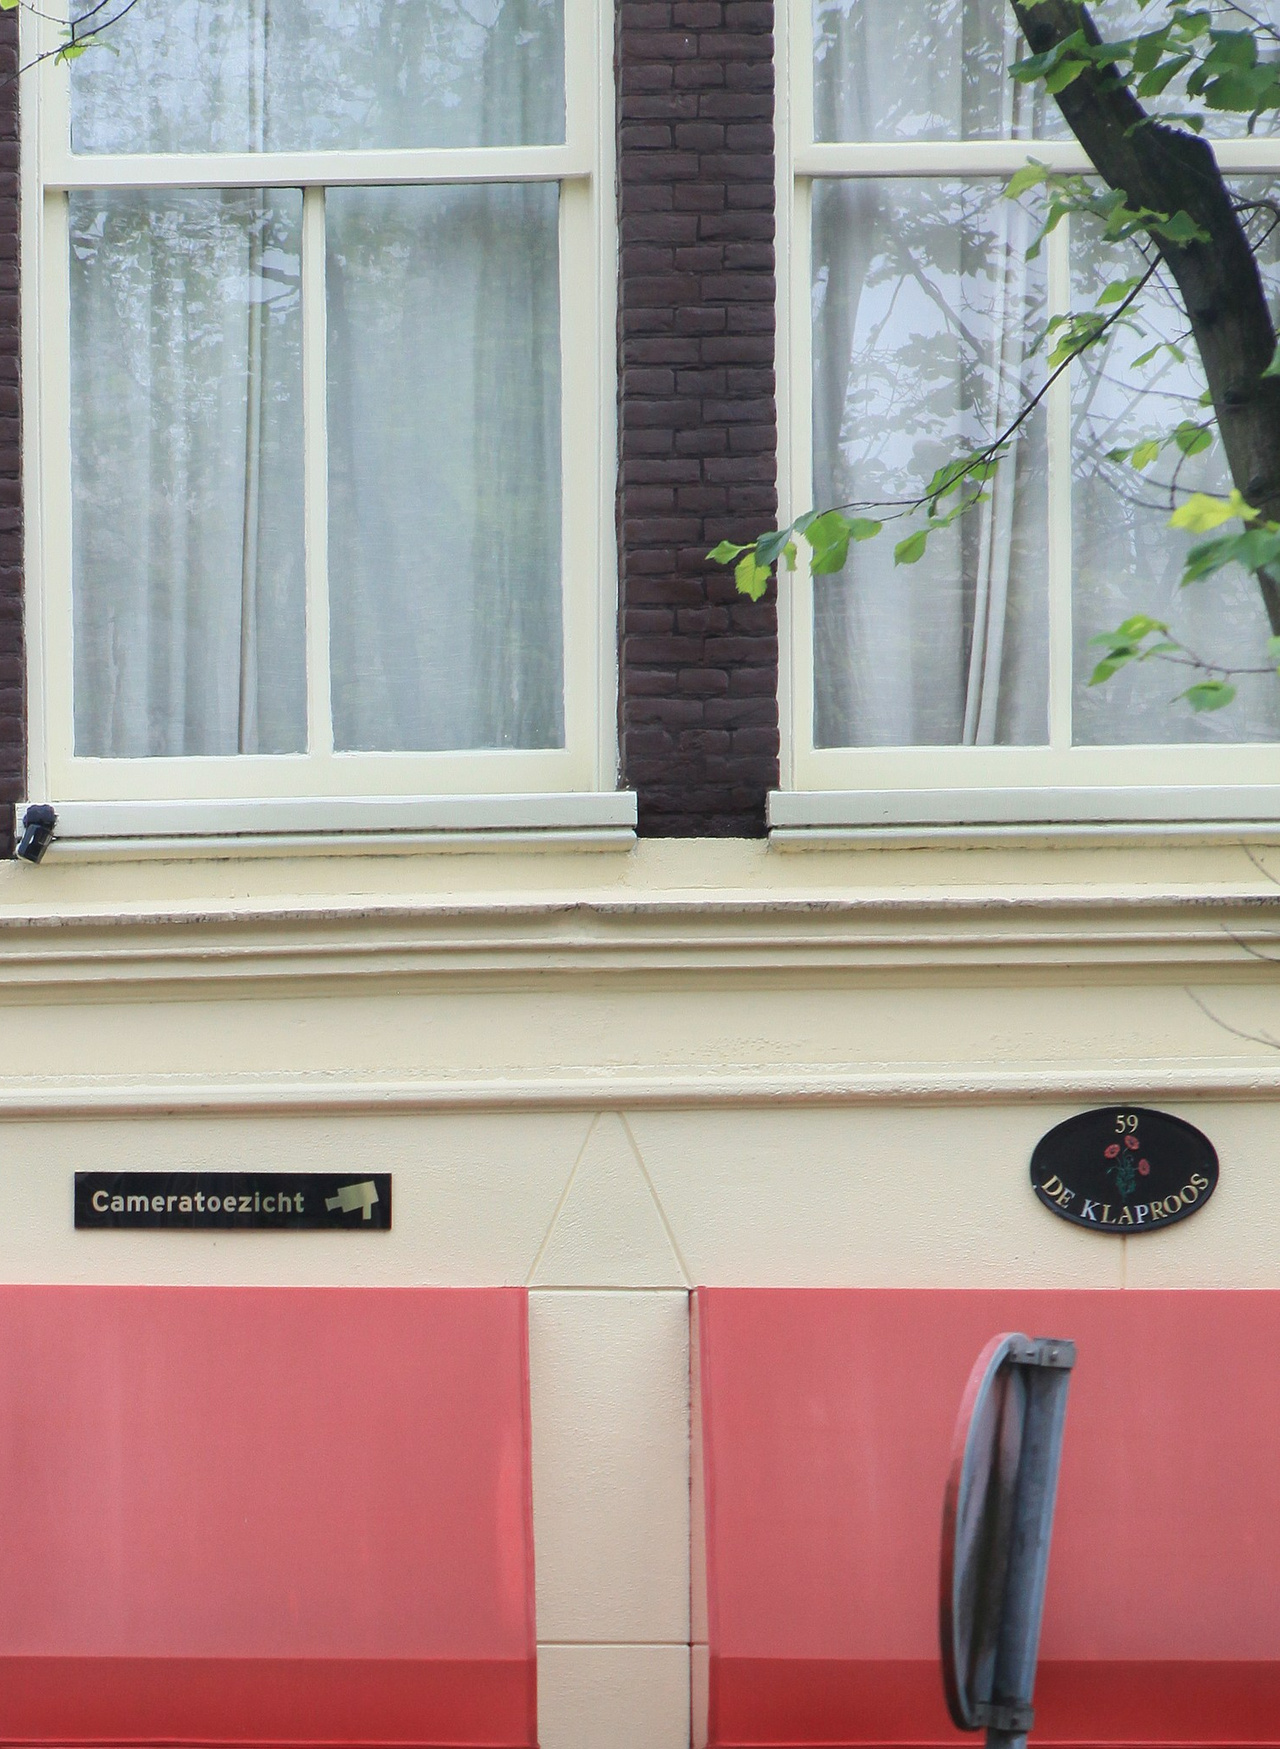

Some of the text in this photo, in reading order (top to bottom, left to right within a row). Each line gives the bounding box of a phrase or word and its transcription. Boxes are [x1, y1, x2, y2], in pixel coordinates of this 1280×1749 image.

[1115, 1114, 1139, 1134] 59
[91, 1190, 305, 1213] Cameratoezicht
[1041, 1173, 1210, 1225] DE KLAPROOS
